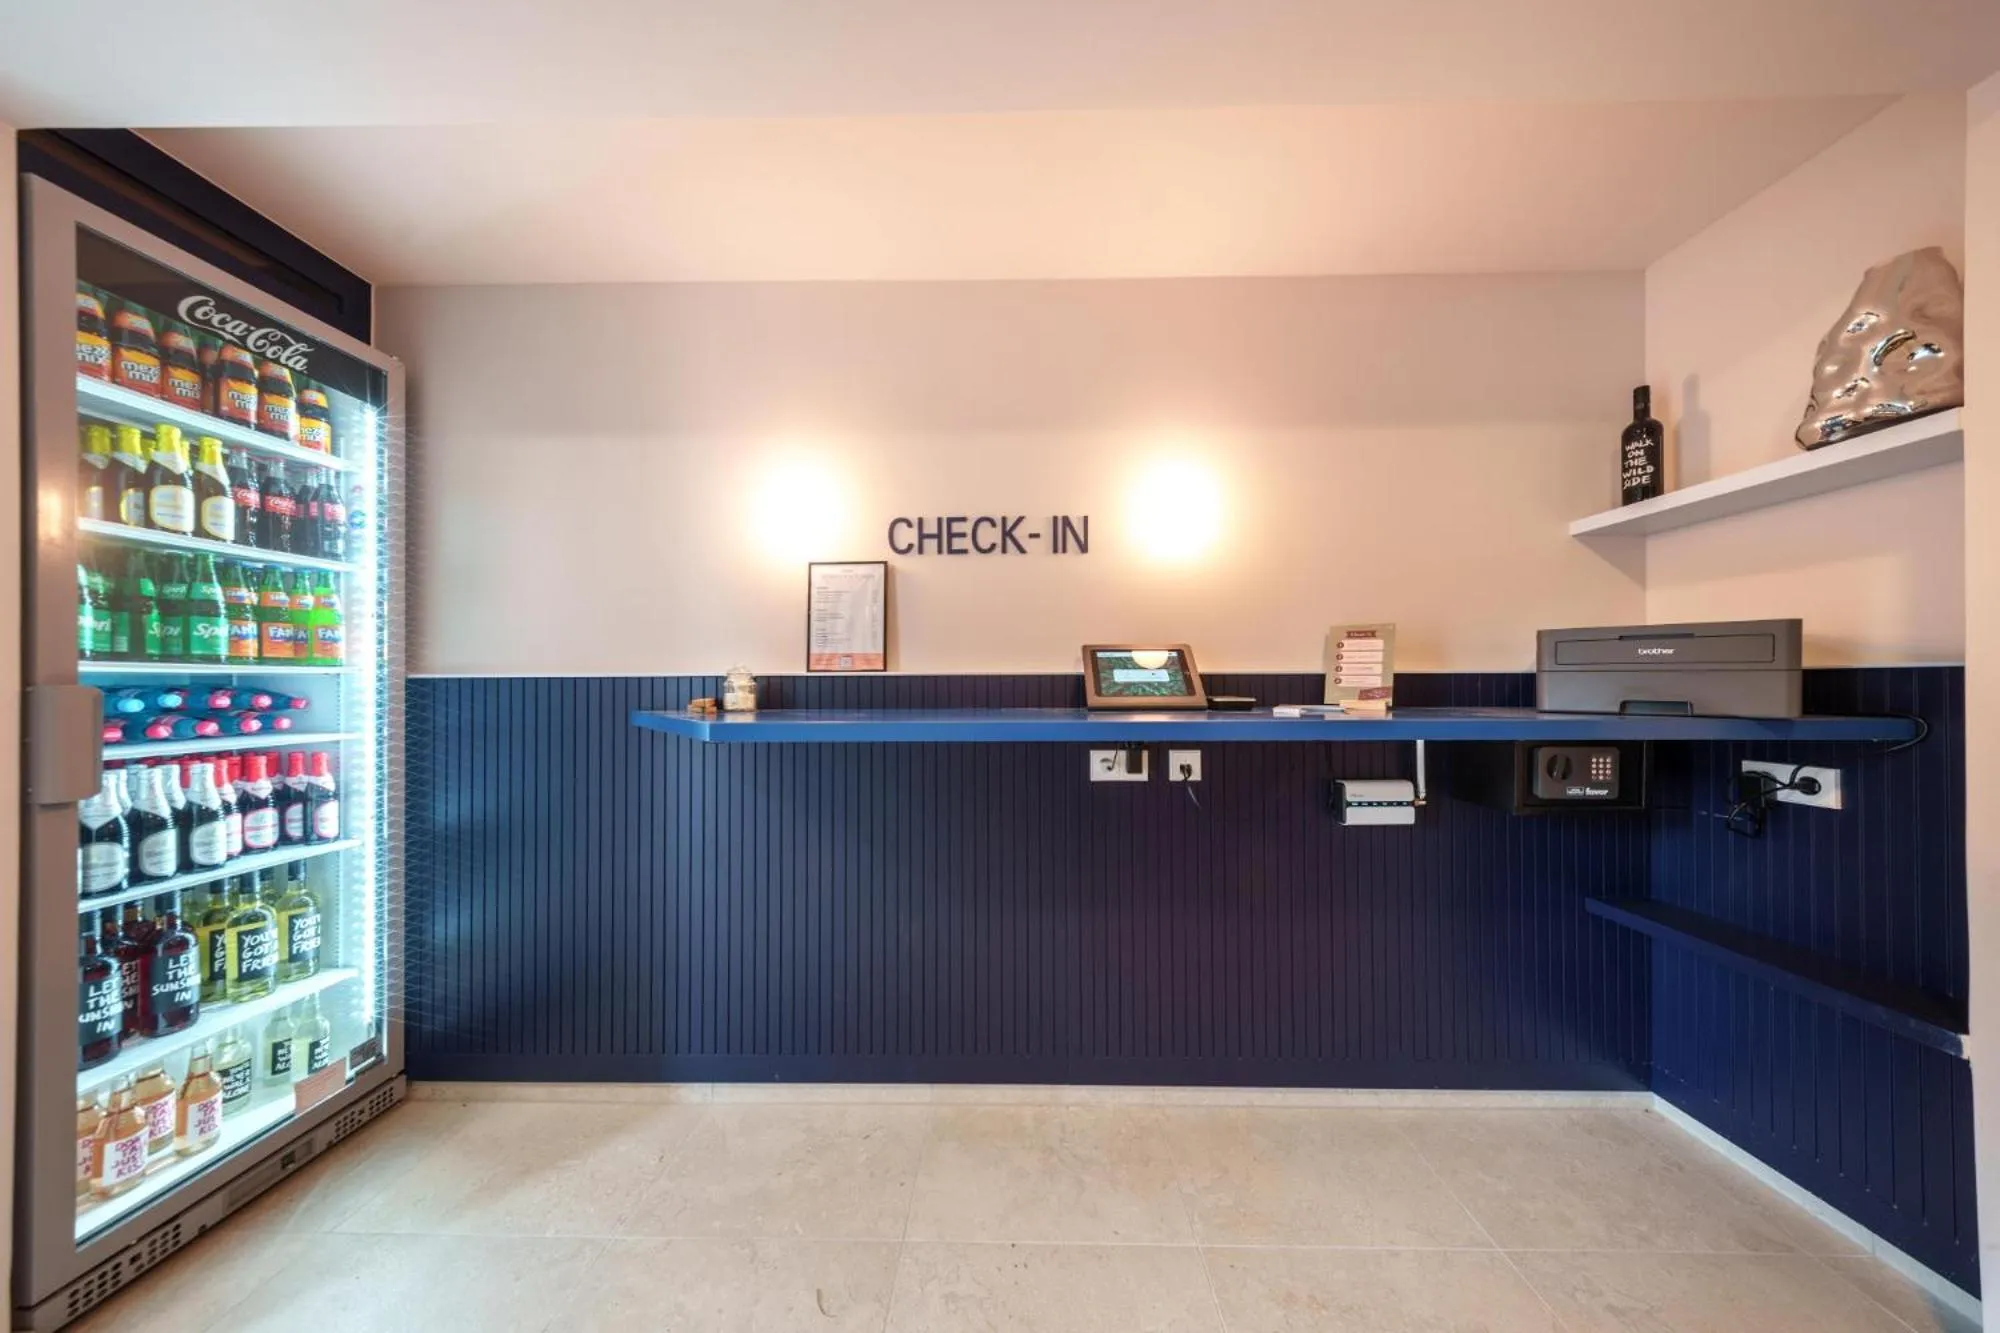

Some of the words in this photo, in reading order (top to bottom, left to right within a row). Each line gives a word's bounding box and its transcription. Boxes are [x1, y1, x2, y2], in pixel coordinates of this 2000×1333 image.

[177, 295, 315, 374] Coca-Cola
[1625, 438, 1654, 451] WALK
[1627, 449, 1645, 458] ON
[1624, 457, 1648, 468] THE
[1622, 465, 1654, 479] WILD
[1638, 647, 1676, 655] brother
[86, 990, 120, 1010] THE
[174, 990, 193, 1003] IN
[96, 1020, 116, 1034] IN
